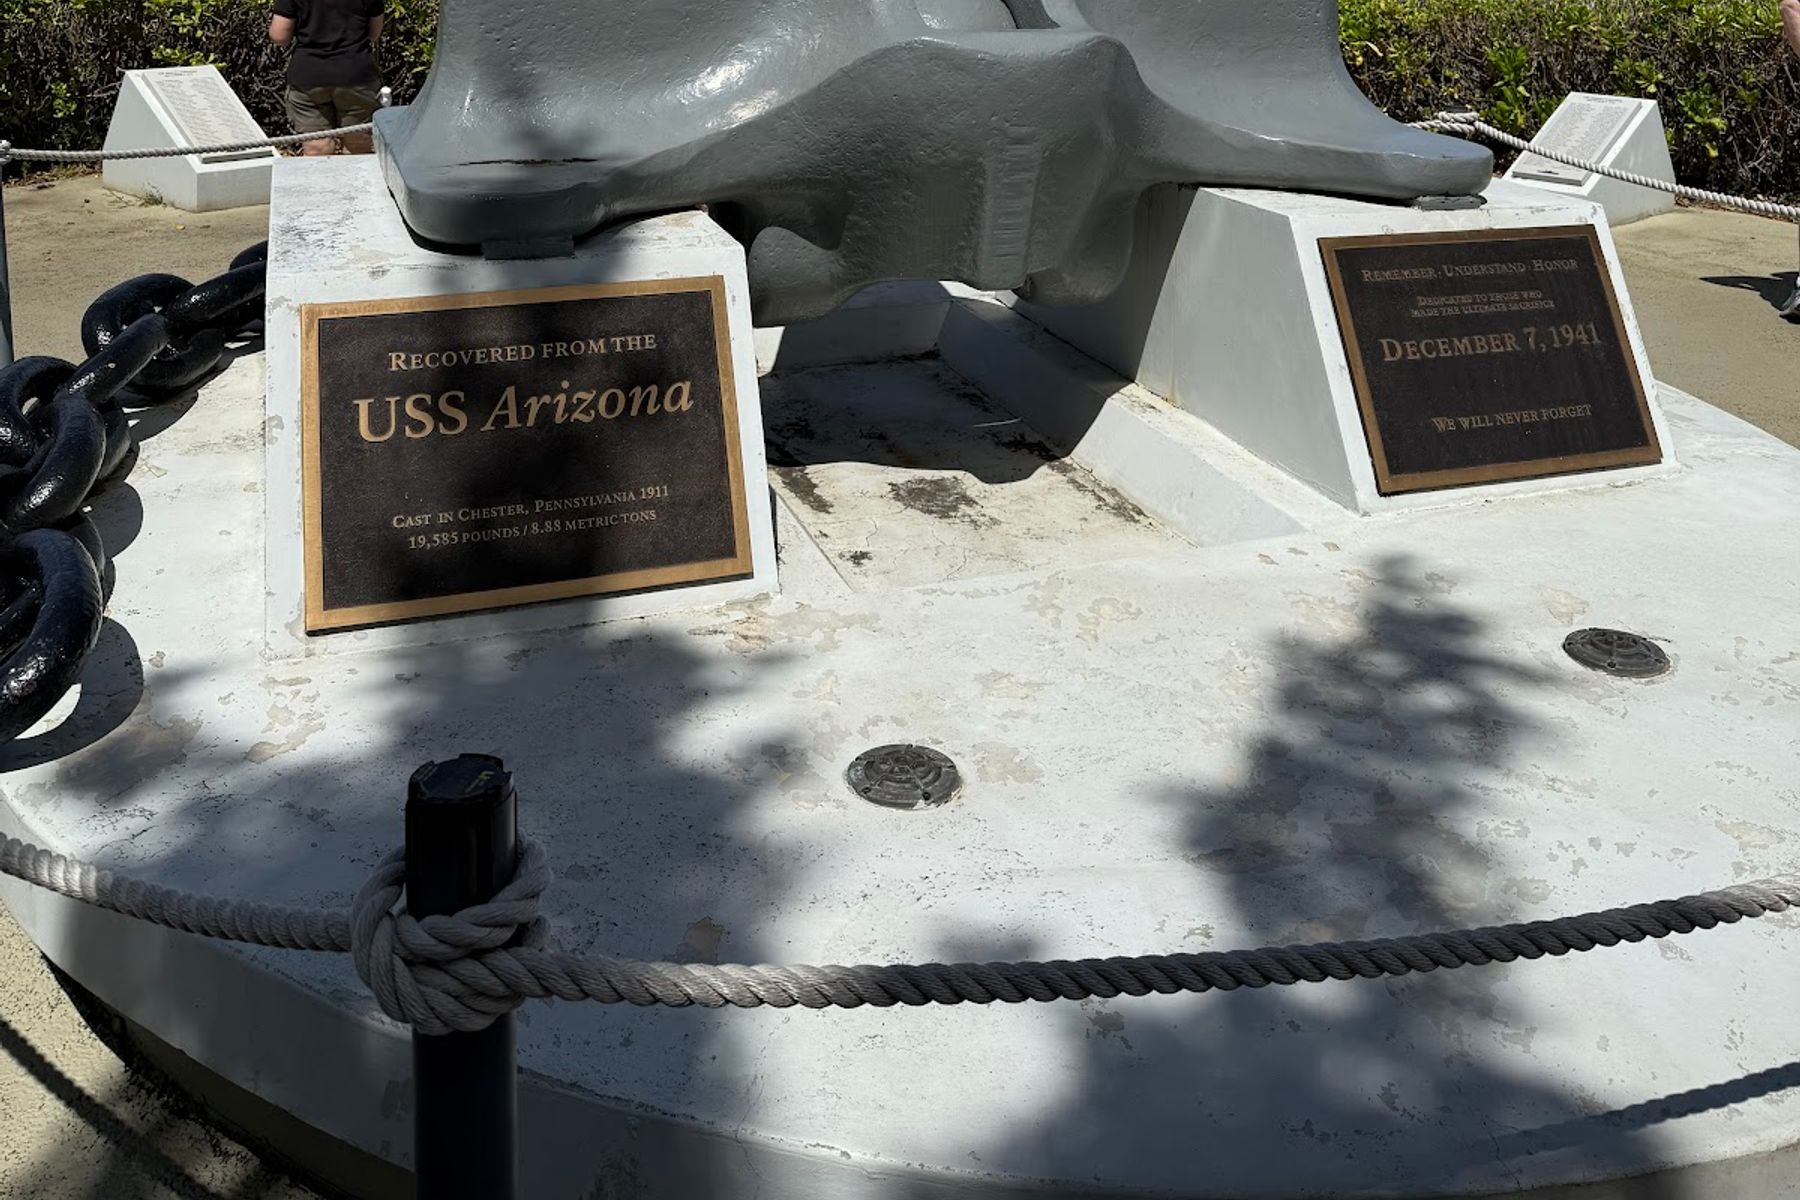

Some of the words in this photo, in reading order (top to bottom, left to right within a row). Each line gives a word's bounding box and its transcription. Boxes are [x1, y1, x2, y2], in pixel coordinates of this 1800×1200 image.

[1361, 267, 1438, 282] REMEMBER
[1442, 262, 1526, 278] UNDERSTAND
[1533, 259, 1579, 272] HONOR
[388, 344, 536, 372] RECOVERED
[541, 339, 607, 359] FROM
[610, 334, 657, 353] THE
[1378, 332, 1520, 362] DECEMBER
[1523, 326, 1547, 352] 7,
[1550, 321, 1601, 348] 1941
[353, 390, 469, 443] USS
[480, 380, 694, 432] Arizona
[1431, 416, 1457, 432] WE
[1458, 415, 1494, 431] WILL
[1494, 410, 1539, 426] NEVER
[1541, 403, 1593, 421] FORGET
[392, 513, 432, 529] CAST
[437, 511, 454, 524] IN
[458, 503, 530, 522] CHESTER,
[534, 491, 636, 514] PENNSYLVANIA
[640, 484, 669, 500] 1911
[409, 531, 459, 550] 19,585
[461, 526, 520, 543] POUNDS
[531, 519, 561, 535] 8.88
[565, 514, 619, 531] METRIC
[620, 509, 657, 524] TONS
